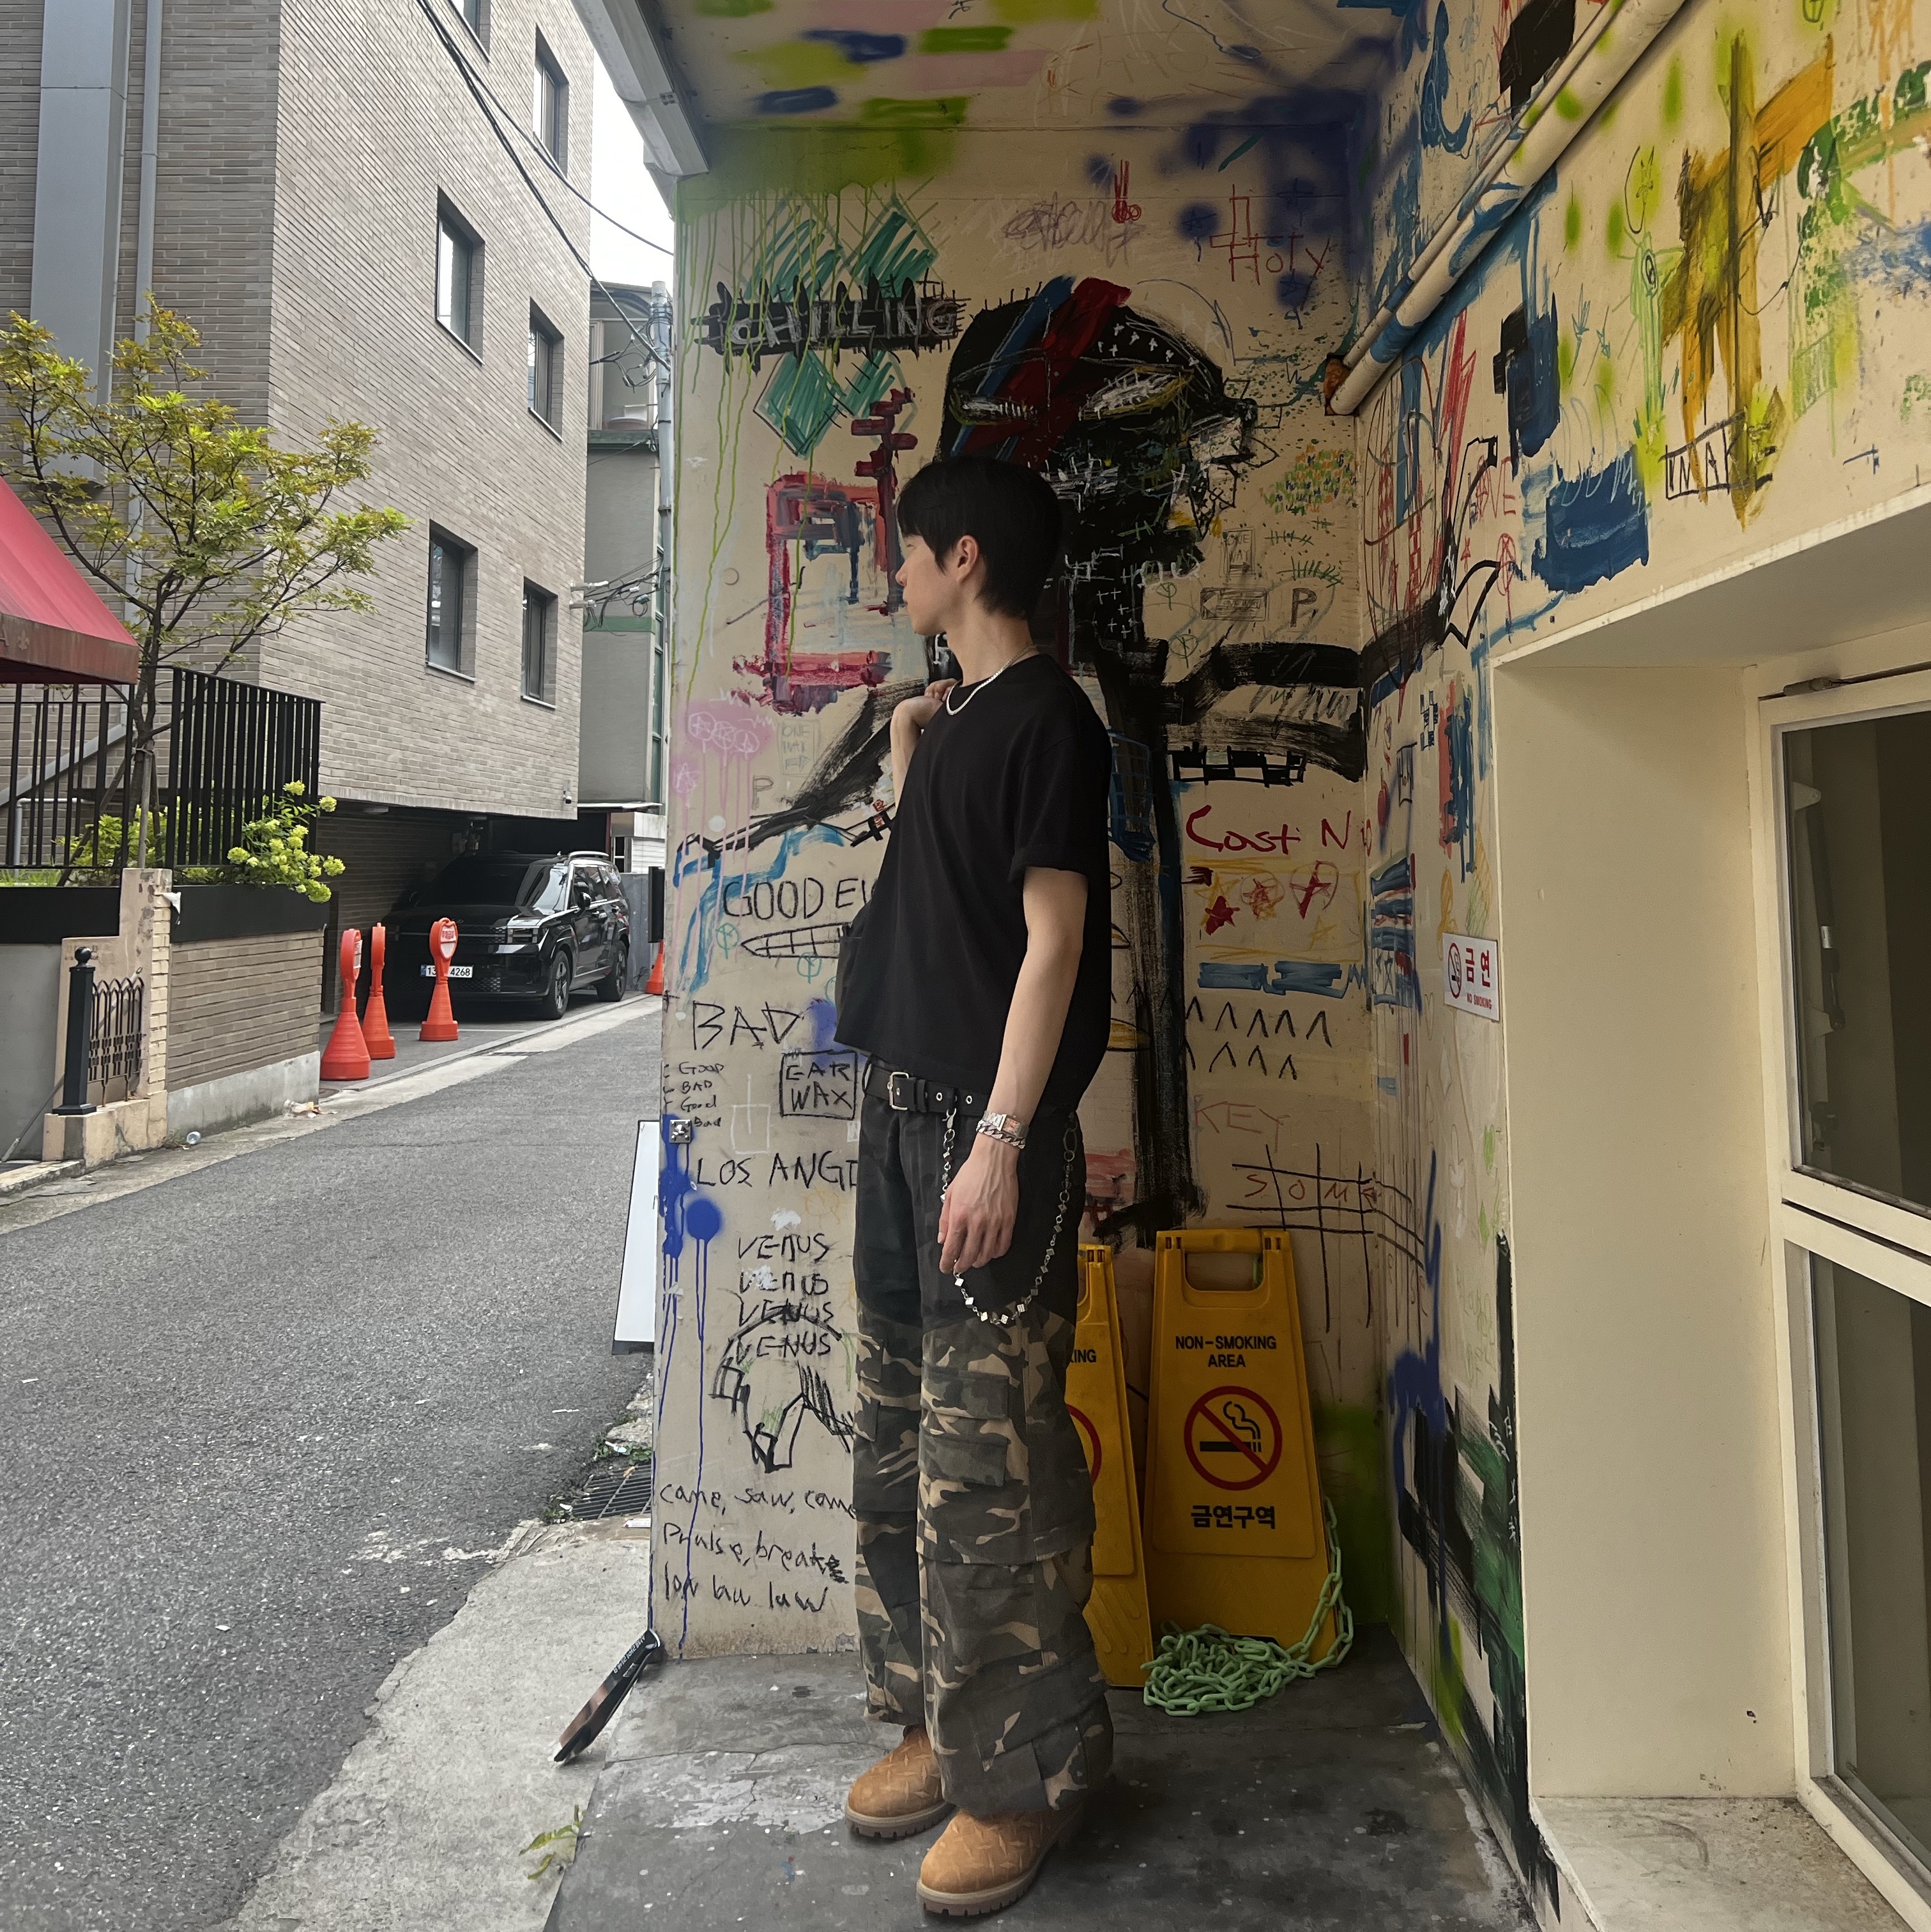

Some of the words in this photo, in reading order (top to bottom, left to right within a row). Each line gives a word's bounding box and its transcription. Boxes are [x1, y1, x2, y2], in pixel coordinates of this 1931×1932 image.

[1290, 587, 1317, 628] P
[751, 774, 774, 811] P
[1186, 804, 1301, 855] Cost
[723, 877, 824, 920] GOOD
[450, 967, 471, 977] 4268
[1465, 947, 1491, 988] 금연
[1467, 992, 1472, 1004] NO
[1473, 994, 1492, 1010] SMOKING
[693, 1000, 801, 1050] BAD
[785, 1062, 851, 1081] EAR
[681, 1080, 713, 1094] BAD
[791, 1081, 853, 1113] WAX
[680, 1094, 717, 1113] Good
[1194, 1095, 1290, 1153] KEY
[697, 1156, 752, 1188] LOS
[1071, 1349, 1097, 1363] ING
[1175, 1336, 1277, 1350] NON-SMOKING
[1207, 1354, 1246, 1368] AREA
[1191, 1505, 1276, 1530] 금연구역
